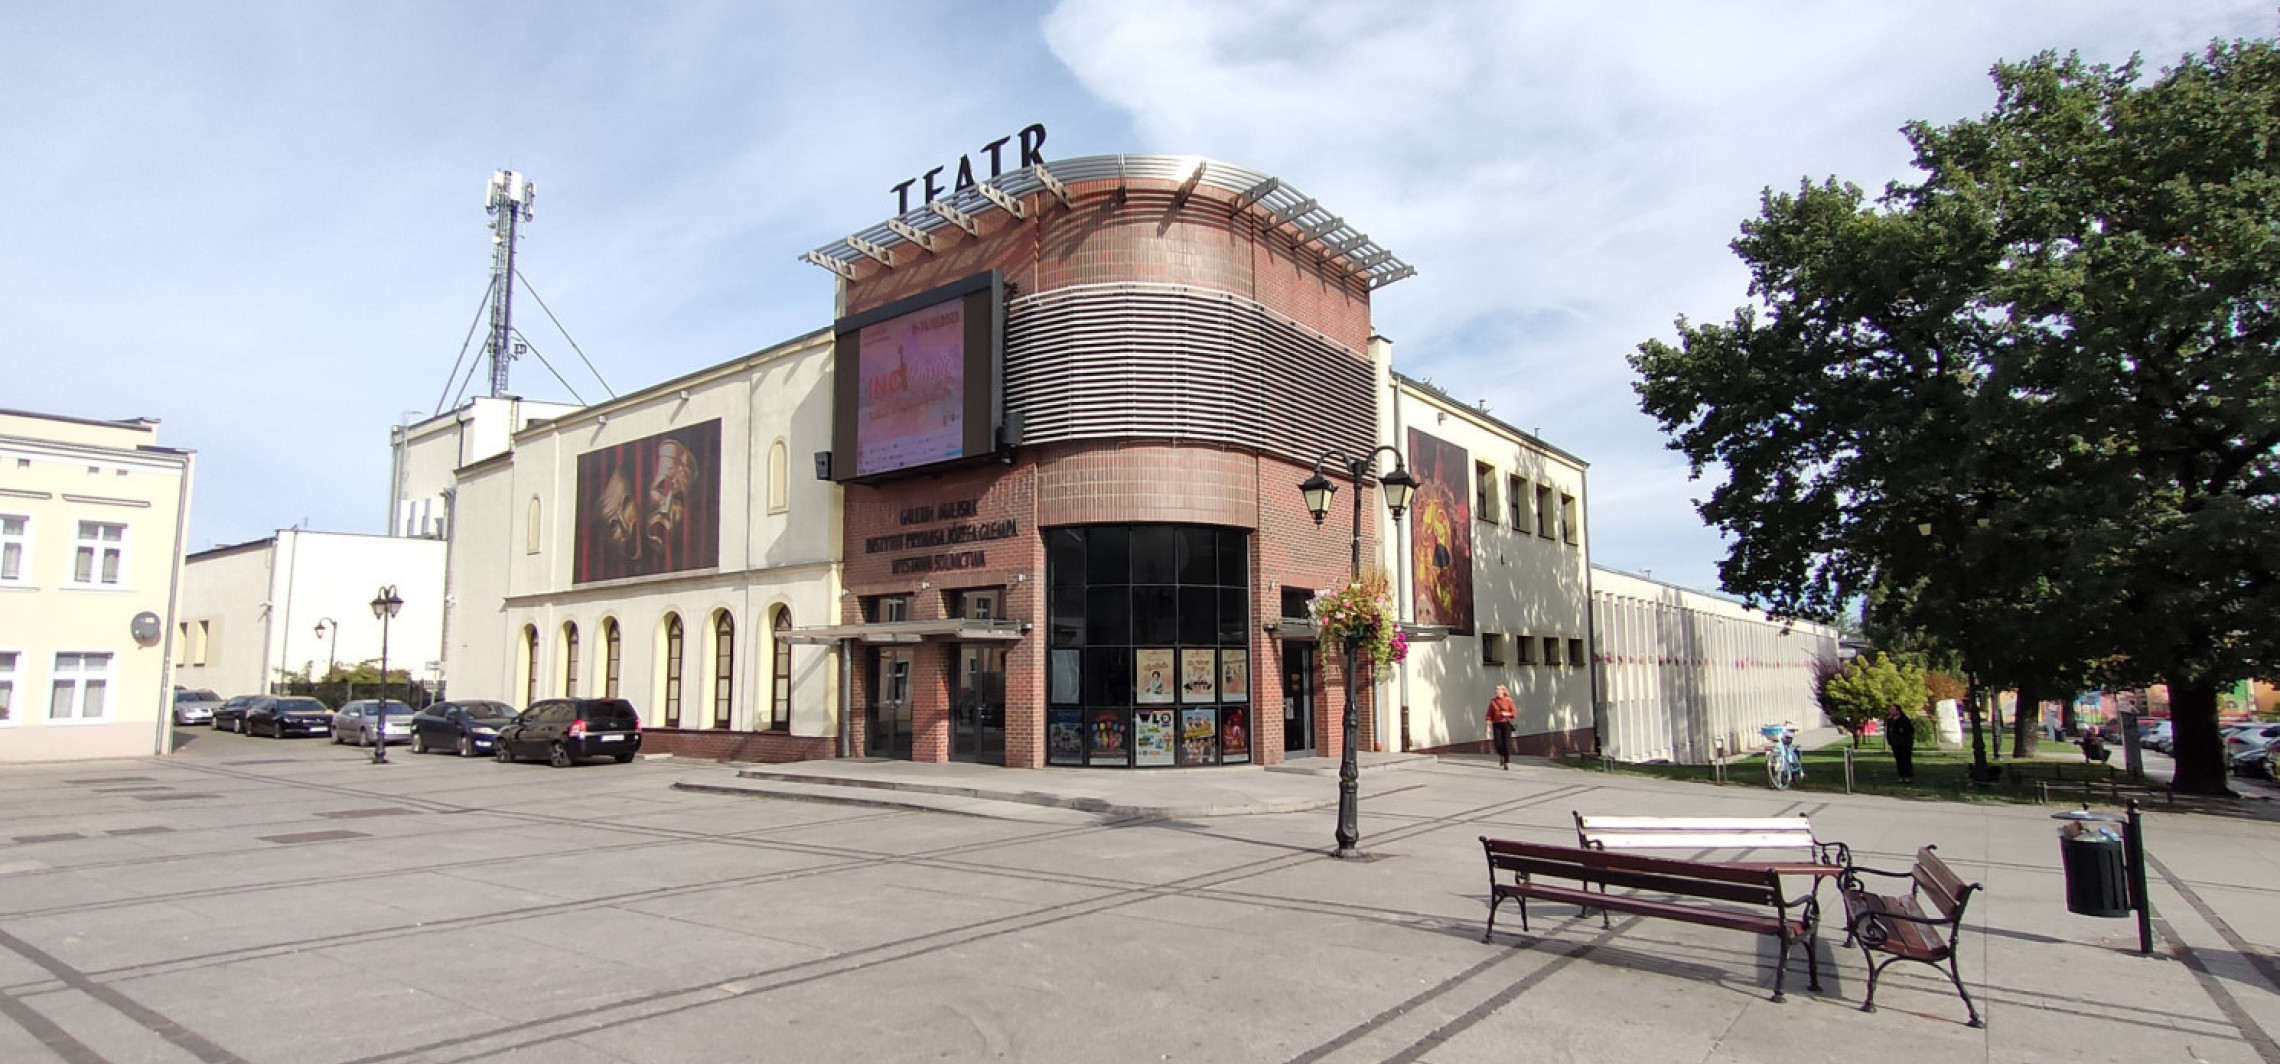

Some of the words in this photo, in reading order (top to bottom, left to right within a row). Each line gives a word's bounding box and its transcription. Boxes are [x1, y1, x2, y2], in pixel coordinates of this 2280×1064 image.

[889, 123, 1047, 216] TEATR
[900, 506, 934, 525] GALERIA
[938, 500, 978, 519] MIEJSKA
[866, 534, 904, 553] INSTYTUT
[978, 519, 1018, 540] GLEMPA
